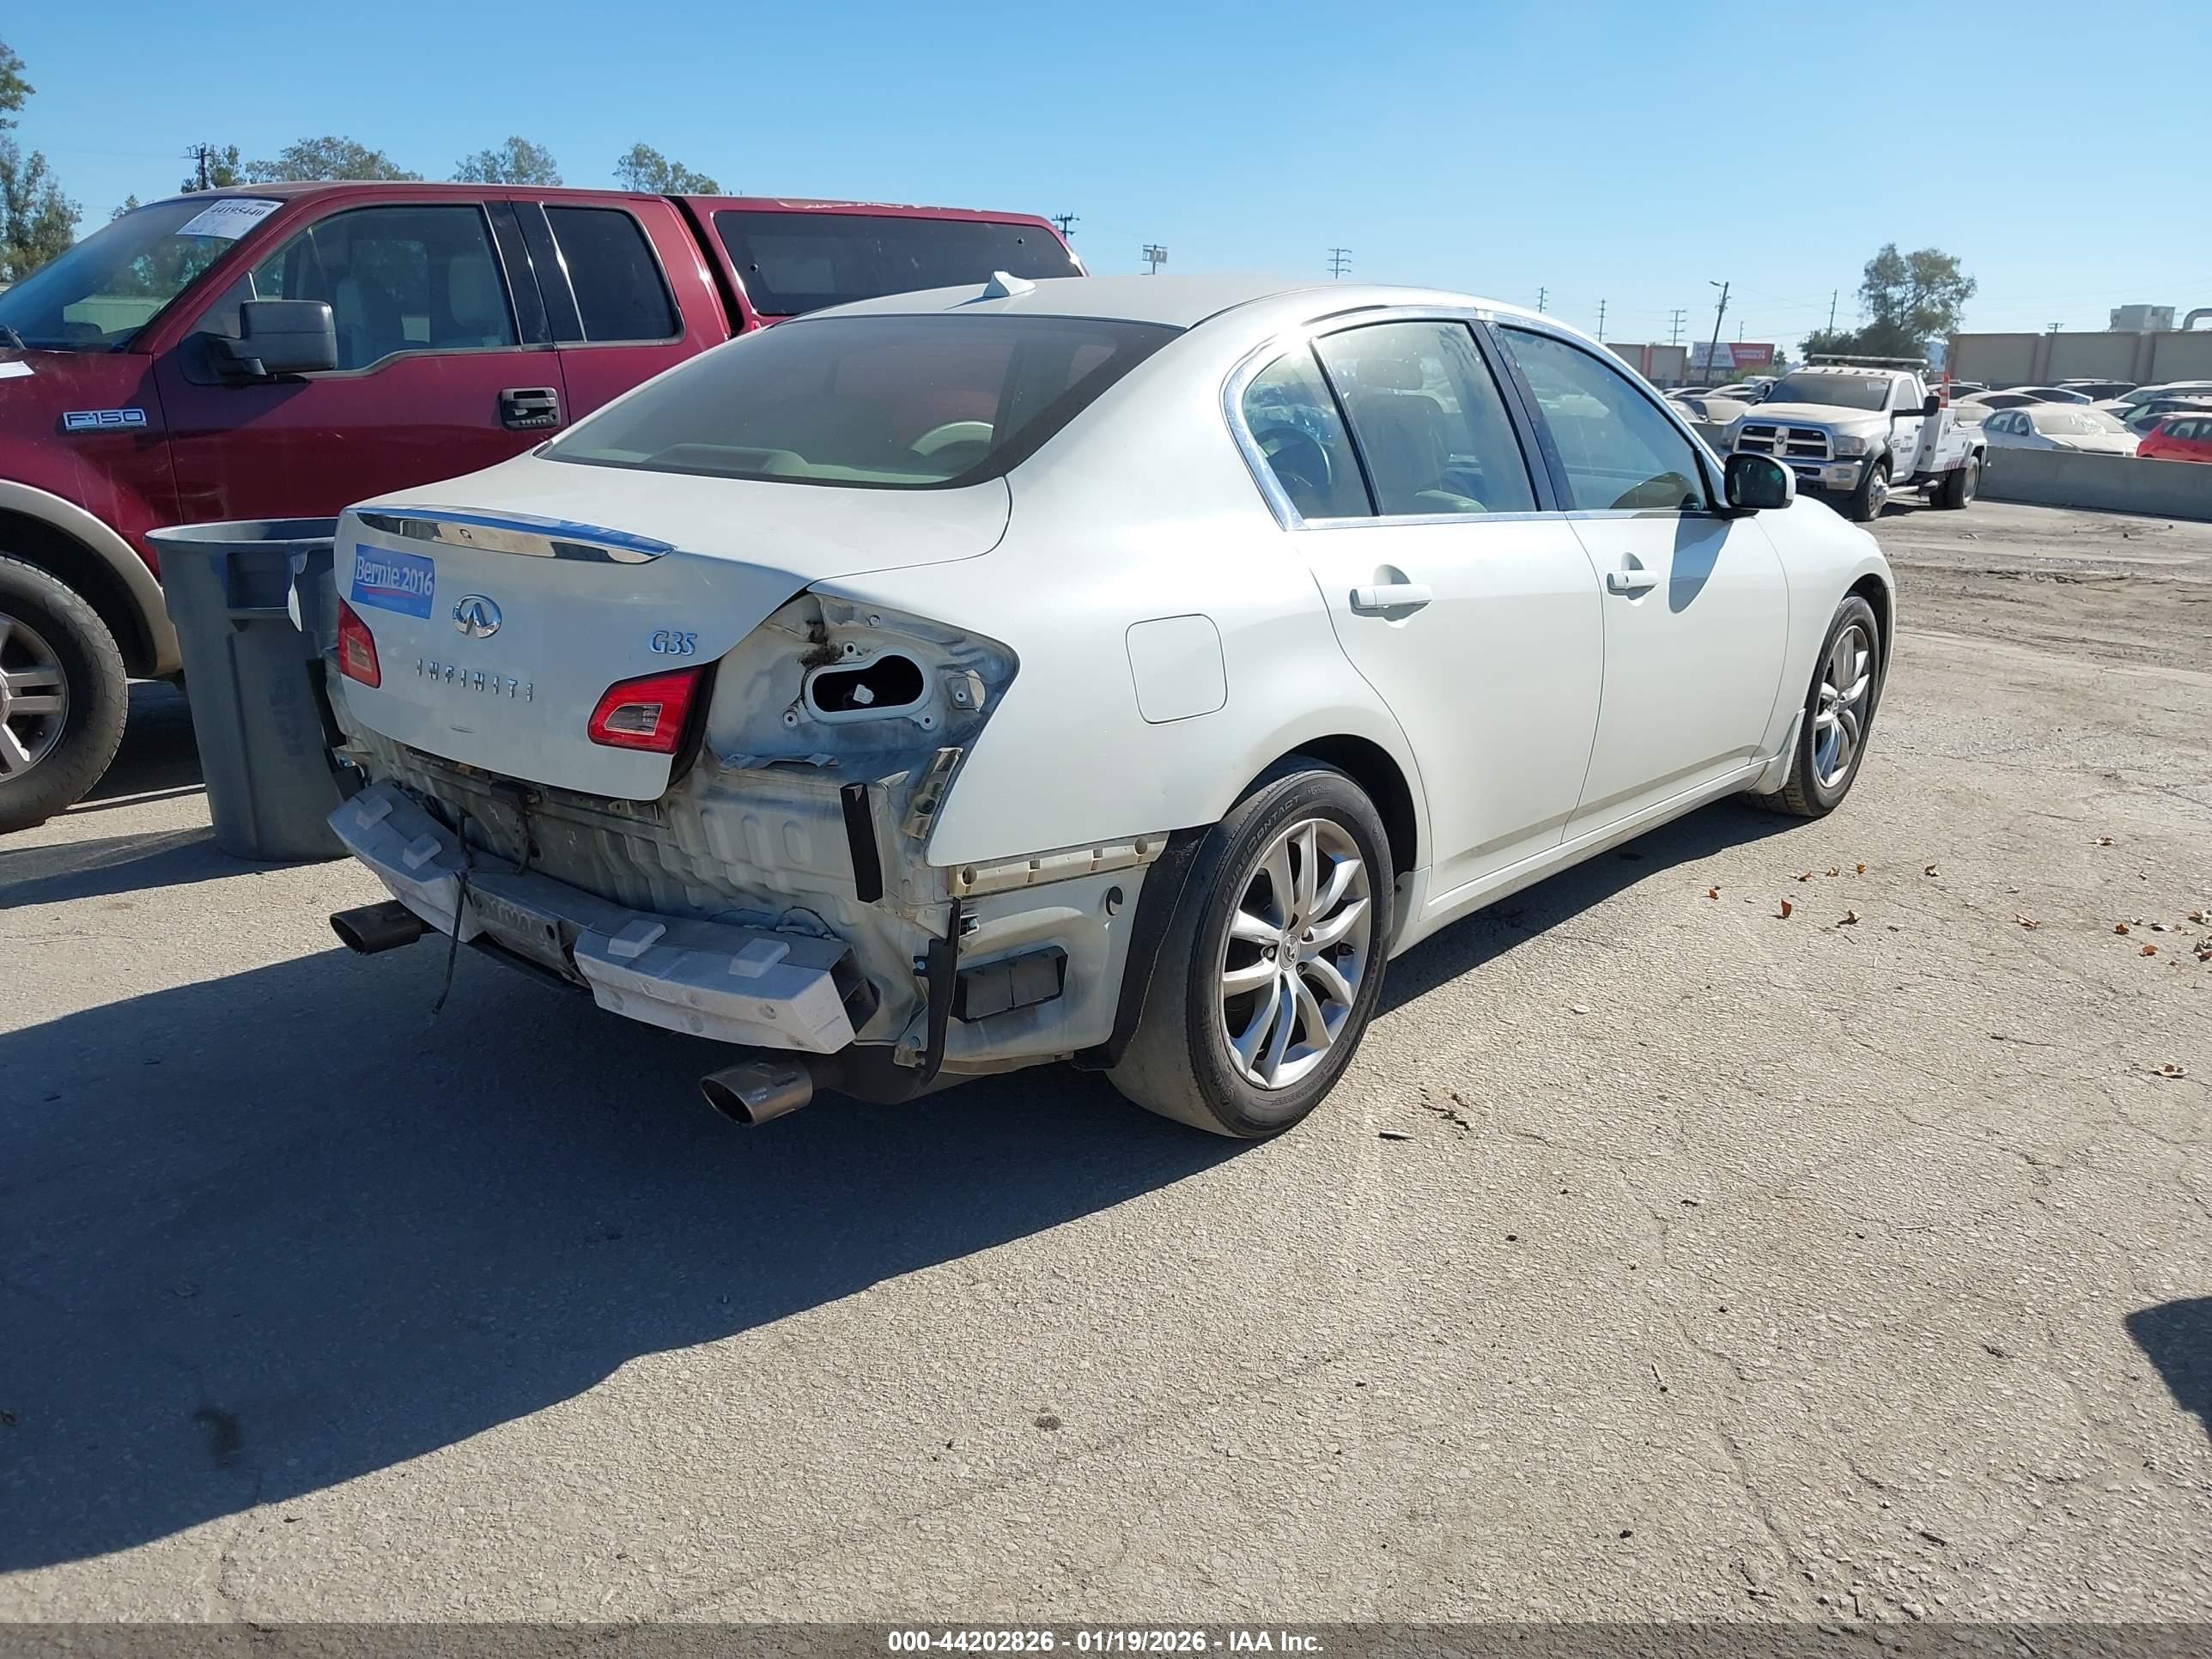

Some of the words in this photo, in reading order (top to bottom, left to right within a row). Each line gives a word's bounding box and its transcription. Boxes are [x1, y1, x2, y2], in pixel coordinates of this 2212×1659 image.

[355, 556, 400, 587] Bernie
[401, 567, 434, 597] 2016
[649, 630, 698, 656] G35
[416, 658, 533, 702] INFINITI
